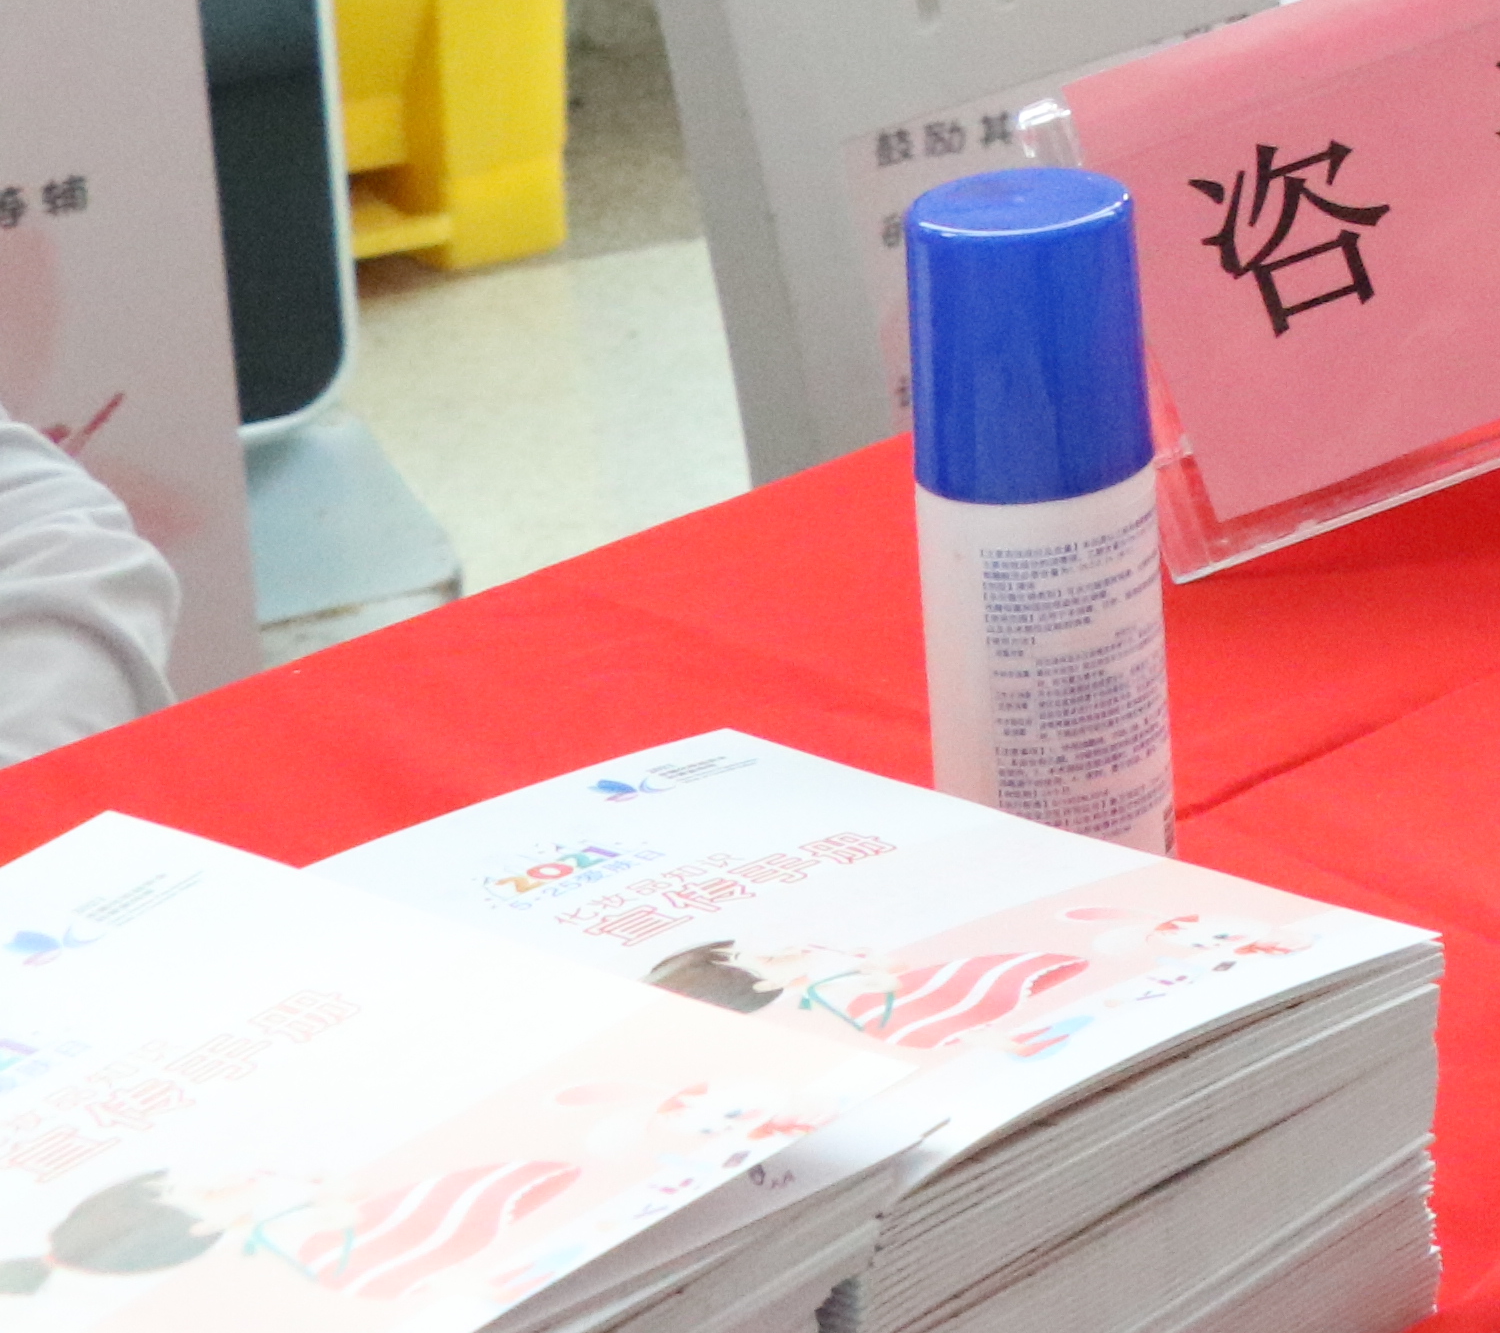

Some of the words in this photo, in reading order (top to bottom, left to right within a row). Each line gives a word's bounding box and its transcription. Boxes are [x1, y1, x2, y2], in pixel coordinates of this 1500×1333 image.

[497, 846, 622, 895] 2021
[554, 851, 747, 924] 化妆品知识
[583, 831, 898, 948] 宣传手册
